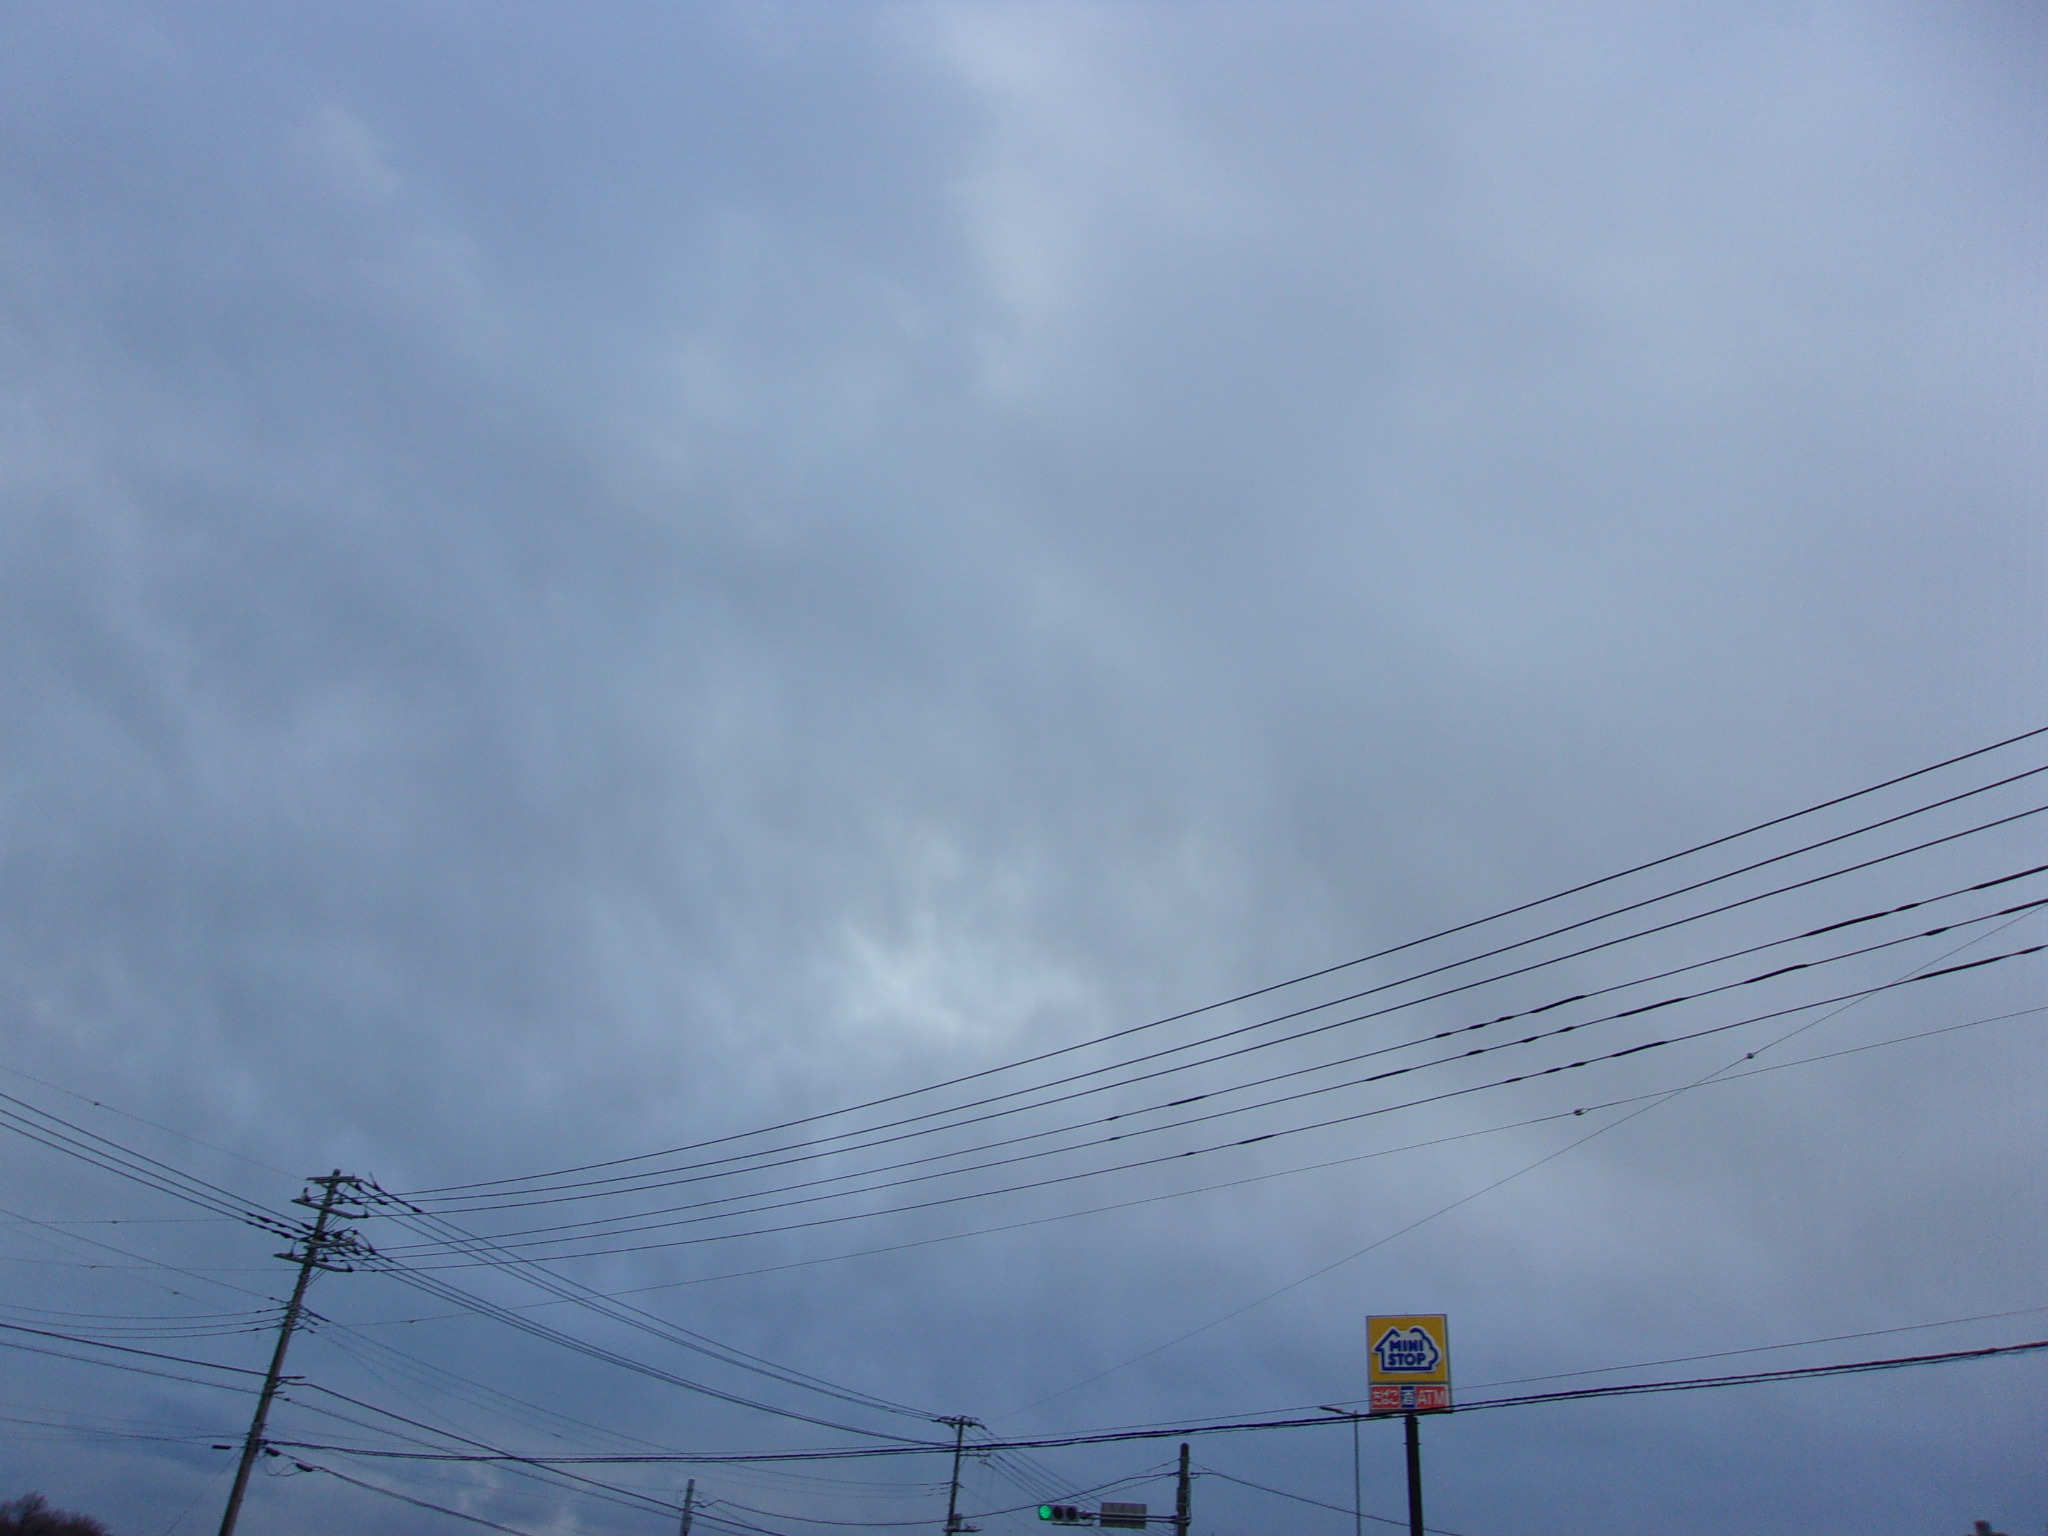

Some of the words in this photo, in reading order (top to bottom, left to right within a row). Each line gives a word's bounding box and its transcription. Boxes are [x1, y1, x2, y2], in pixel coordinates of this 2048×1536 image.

[1389, 1340, 1423, 1352] MINI
[1388, 1353, 1426, 1366] STOP
[1417, 1389, 1449, 1405] ATM
